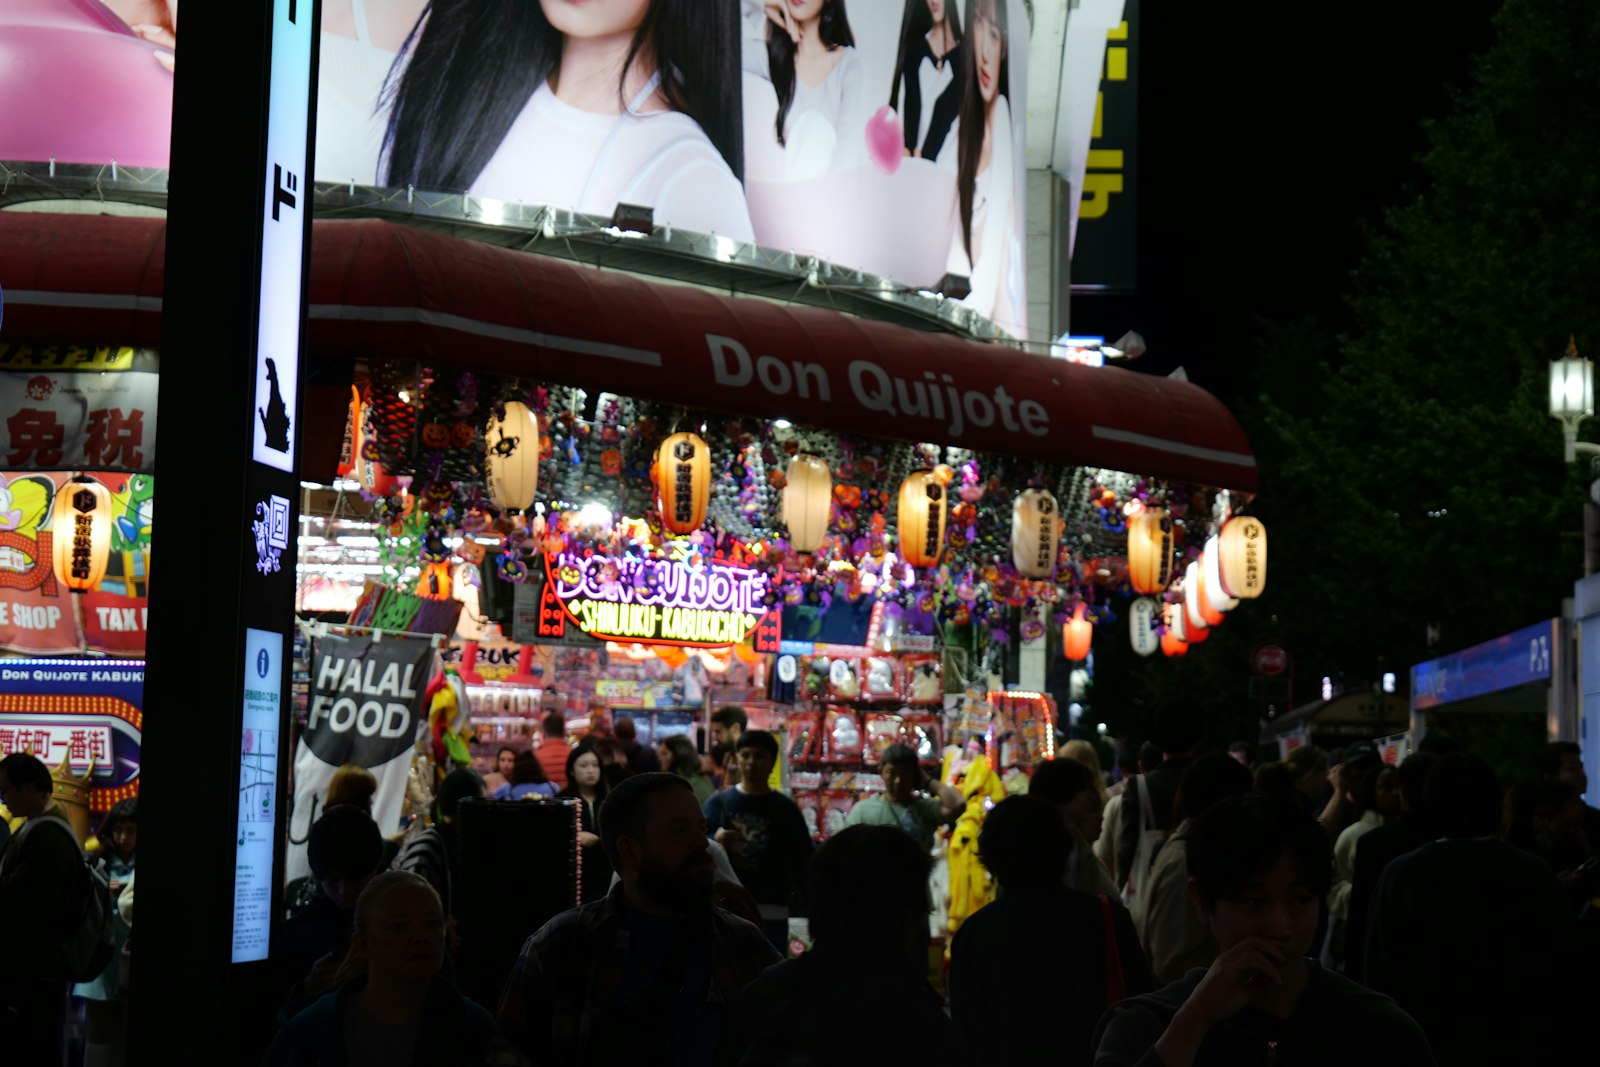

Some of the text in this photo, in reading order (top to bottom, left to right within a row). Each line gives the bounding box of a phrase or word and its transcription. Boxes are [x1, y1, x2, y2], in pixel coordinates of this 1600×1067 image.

[705, 333, 1050, 437] Don Quijote
[6, 407, 144, 468] 免税
[12, 602, 61, 629] SHOP
[96, 607, 139, 631] TAX
[2, 669, 30, 681] DON
[32, 669, 88, 682] QUIJOTE
[317, 655, 416, 698] HALAL
[307, 694, 411, 738] FOOD
